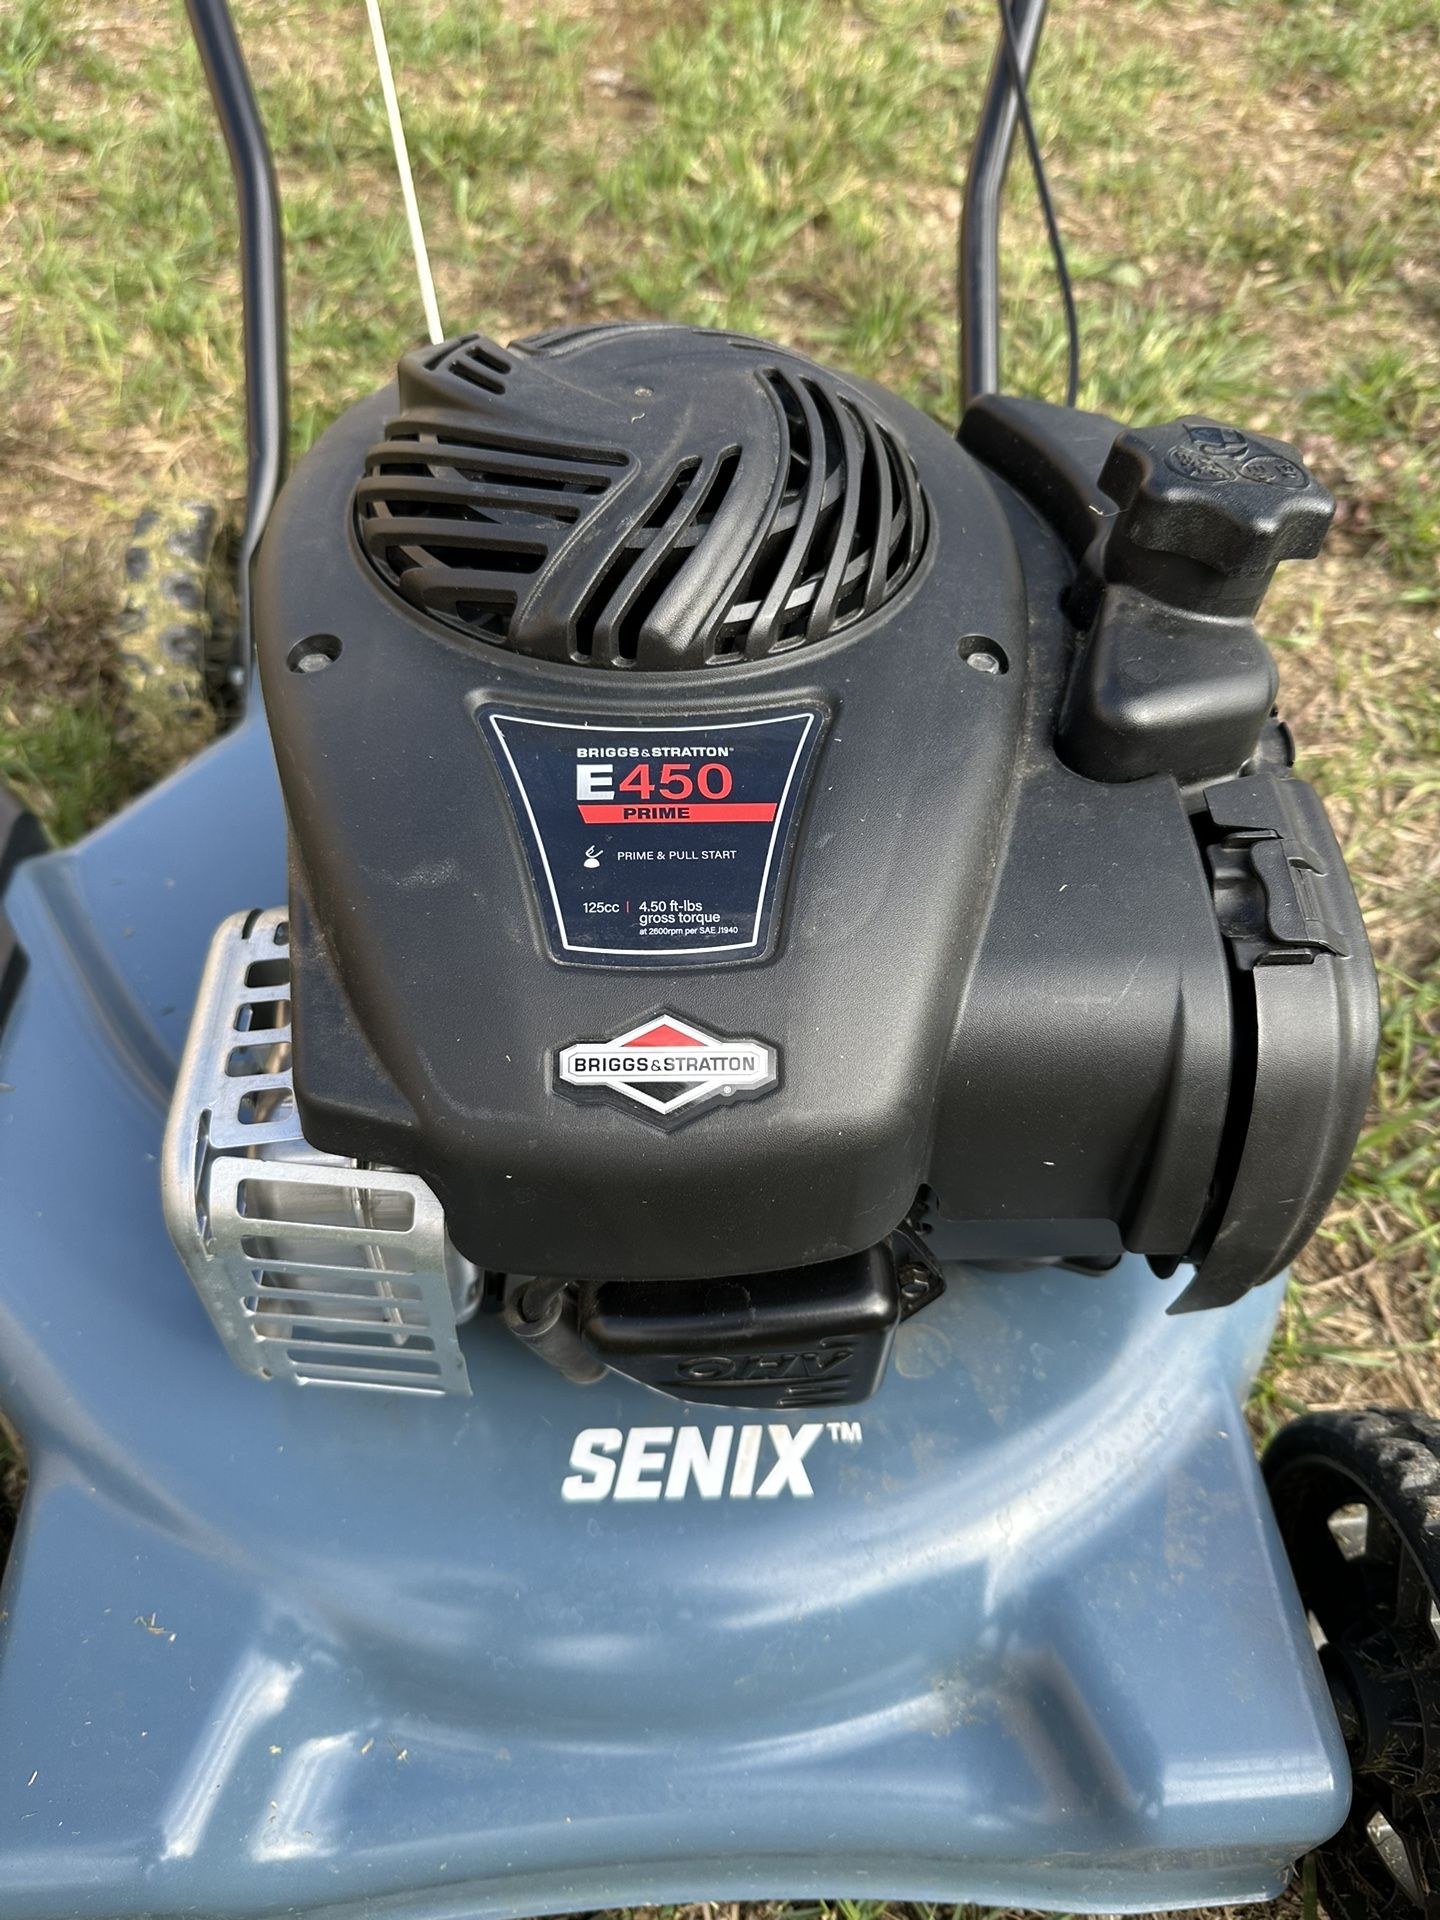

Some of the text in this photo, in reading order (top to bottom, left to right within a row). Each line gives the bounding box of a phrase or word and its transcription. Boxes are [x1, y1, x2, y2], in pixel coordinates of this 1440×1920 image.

[576, 763, 733, 800] E450
[623, 807, 690, 819] PRIME
[617, 850, 737, 860] PRIME & PULL START
[582, 901, 620, 913] 125cc
[638, 899, 703, 912] 4.50 ft-lbs
[639, 913, 721, 926] gross torque
[639, 926, 739, 937] at 2600rpm per SAE J1940
[675, 1352, 857, 1381] OHV
